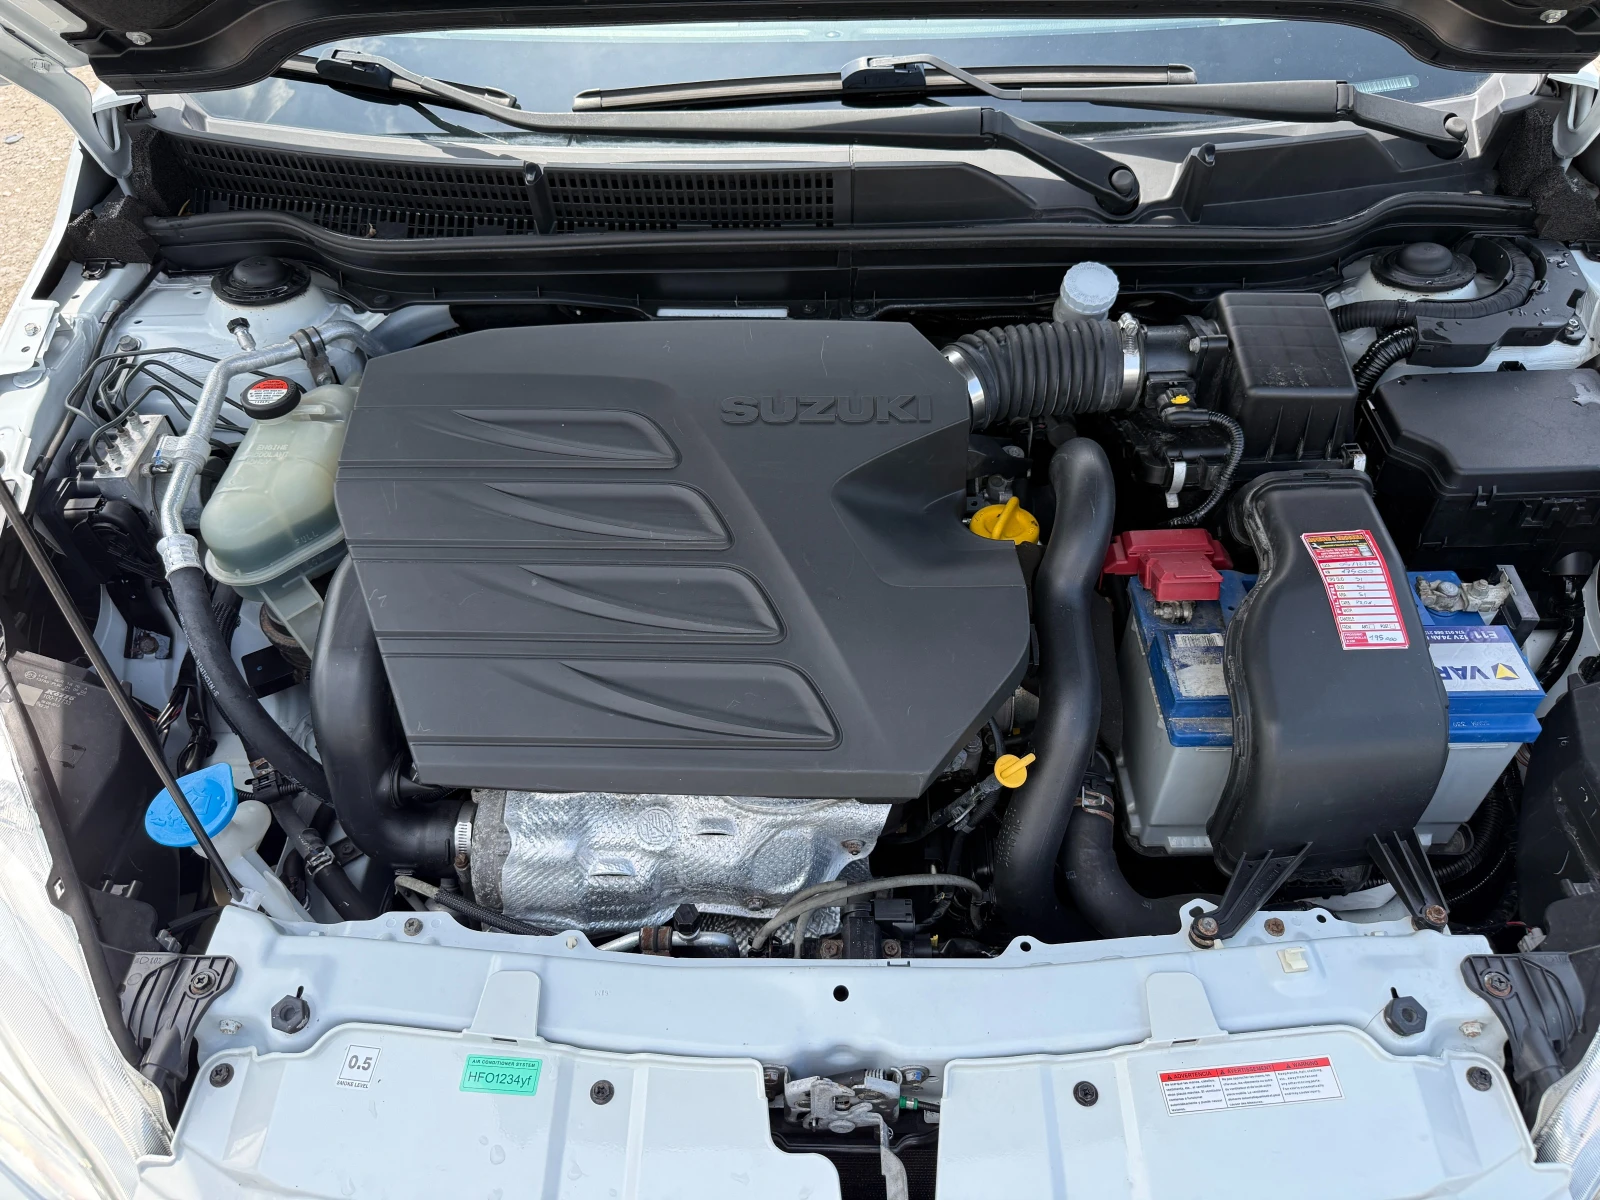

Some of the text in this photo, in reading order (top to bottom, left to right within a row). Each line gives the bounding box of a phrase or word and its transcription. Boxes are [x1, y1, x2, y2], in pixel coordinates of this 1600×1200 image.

[720, 394, 932, 424] SUZUKI
[1471, 630, 1499, 639] E11
[1435, 666, 1490, 680] VAR
[348, 1054, 373, 1071] 0.5
[481, 1059, 515, 1067] CONDITIONER
[1227, 1065, 1272, 1074] AVERTISSEMENT
[467, 1071, 533, 1088] HFO1234yf
[1174, 1071, 1212, 1079] ADVERTENCIA
[336, 1079, 354, 1087] SMOKE
